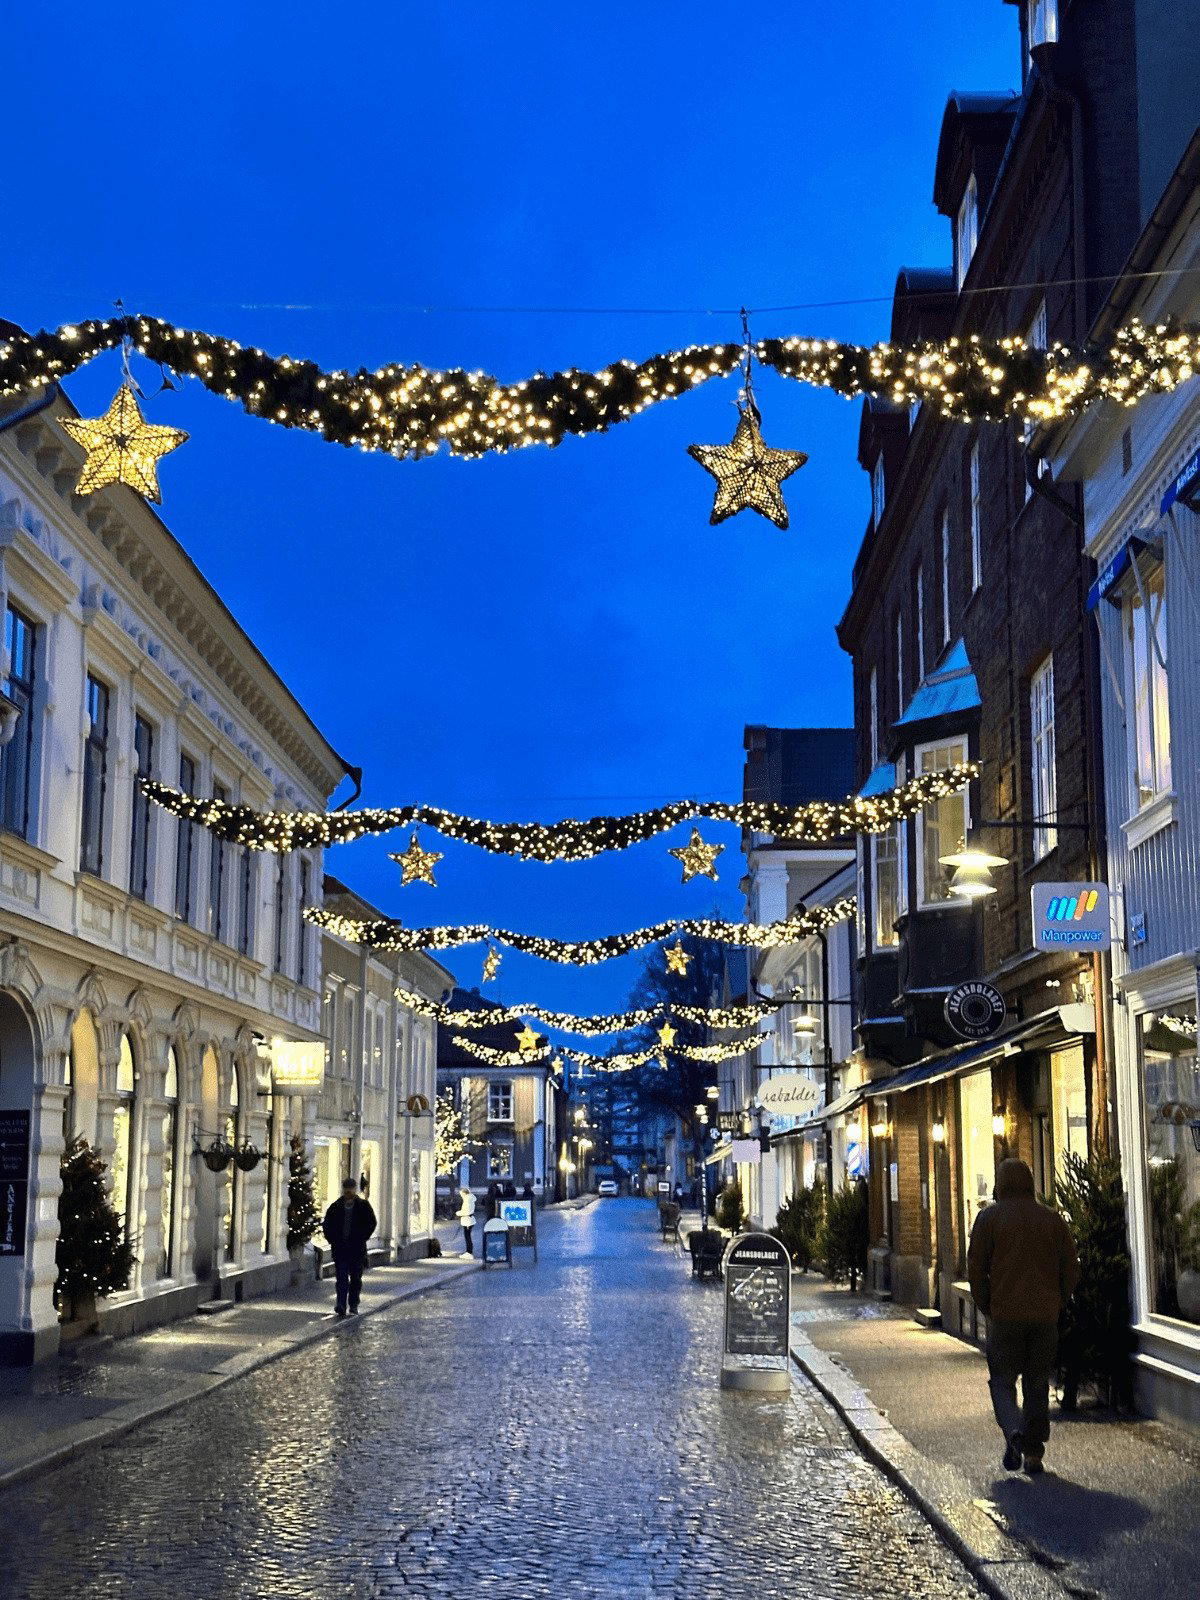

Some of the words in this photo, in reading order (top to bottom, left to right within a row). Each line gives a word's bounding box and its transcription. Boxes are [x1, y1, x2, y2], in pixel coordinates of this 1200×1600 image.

[1042, 929, 1103, 944] Manpower
[949, 983, 1003, 1013] JEANSBOLAGET
[762, 1086, 818, 1104] rabalder
[735, 1250, 779, 1259] JEANSBOLAGET
